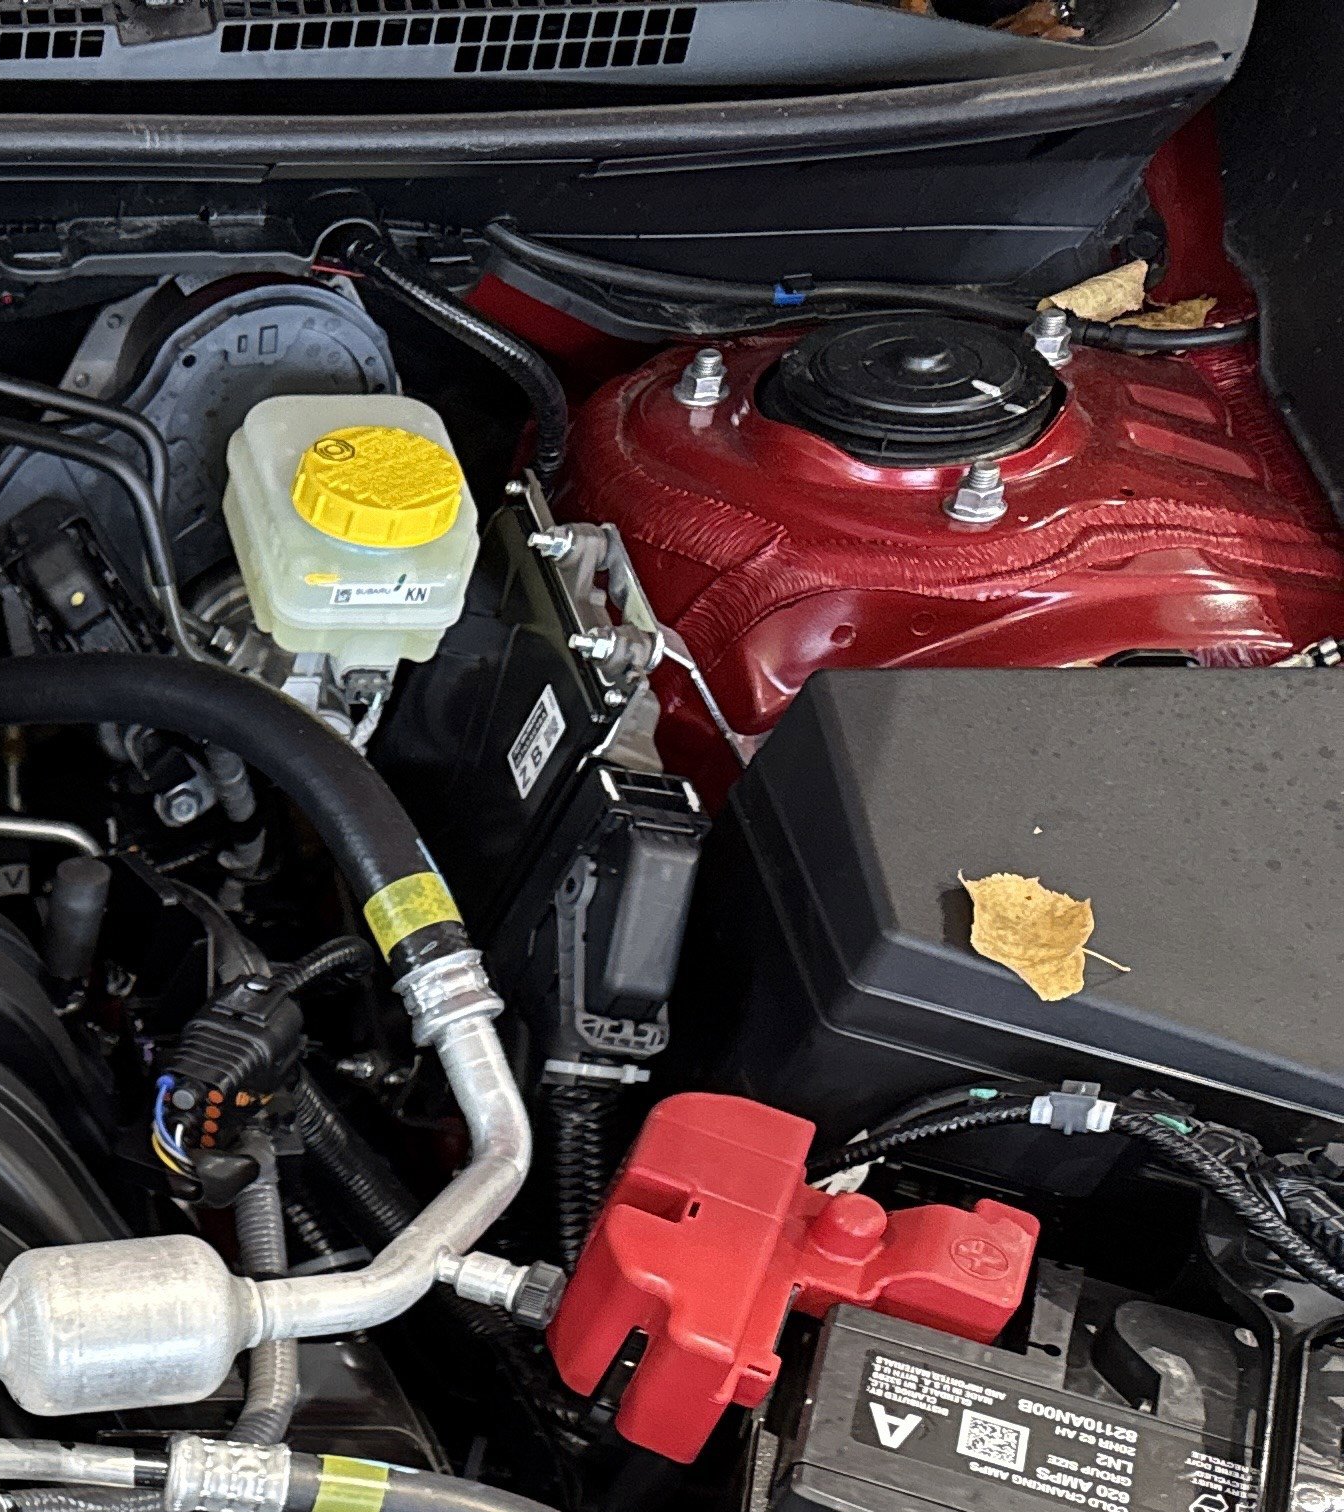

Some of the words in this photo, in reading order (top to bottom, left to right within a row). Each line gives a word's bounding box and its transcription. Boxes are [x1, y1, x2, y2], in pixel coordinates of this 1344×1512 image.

[404, 587, 427, 601] KN
[892, 1369, 919, 1383] WITH
[884, 1391, 949, 1417] DISTRIBUTED
[964, 1390, 994, 1406] MADE
[1017, 1399, 1138, 1443] 82110AN00B
[1054, 1425, 1077, 1439] AH
[1078, 1432, 1096, 1445] 62
[1097, 1437, 1136, 1457] 20HR
[969, 1461, 1010, 1481] AMPS
[1046, 1453, 1079, 1472] SIZE
[1095, 1452, 1134, 1475] LN2
[1035, 1466, 1093, 1493] AMPS
[1080, 1465, 1132, 1487] GROUP
[1190, 1478, 1223, 1491] MUST
[1012, 1473, 1087, 1504] CRANKING
[1095, 1484, 1130, 1504] 620
